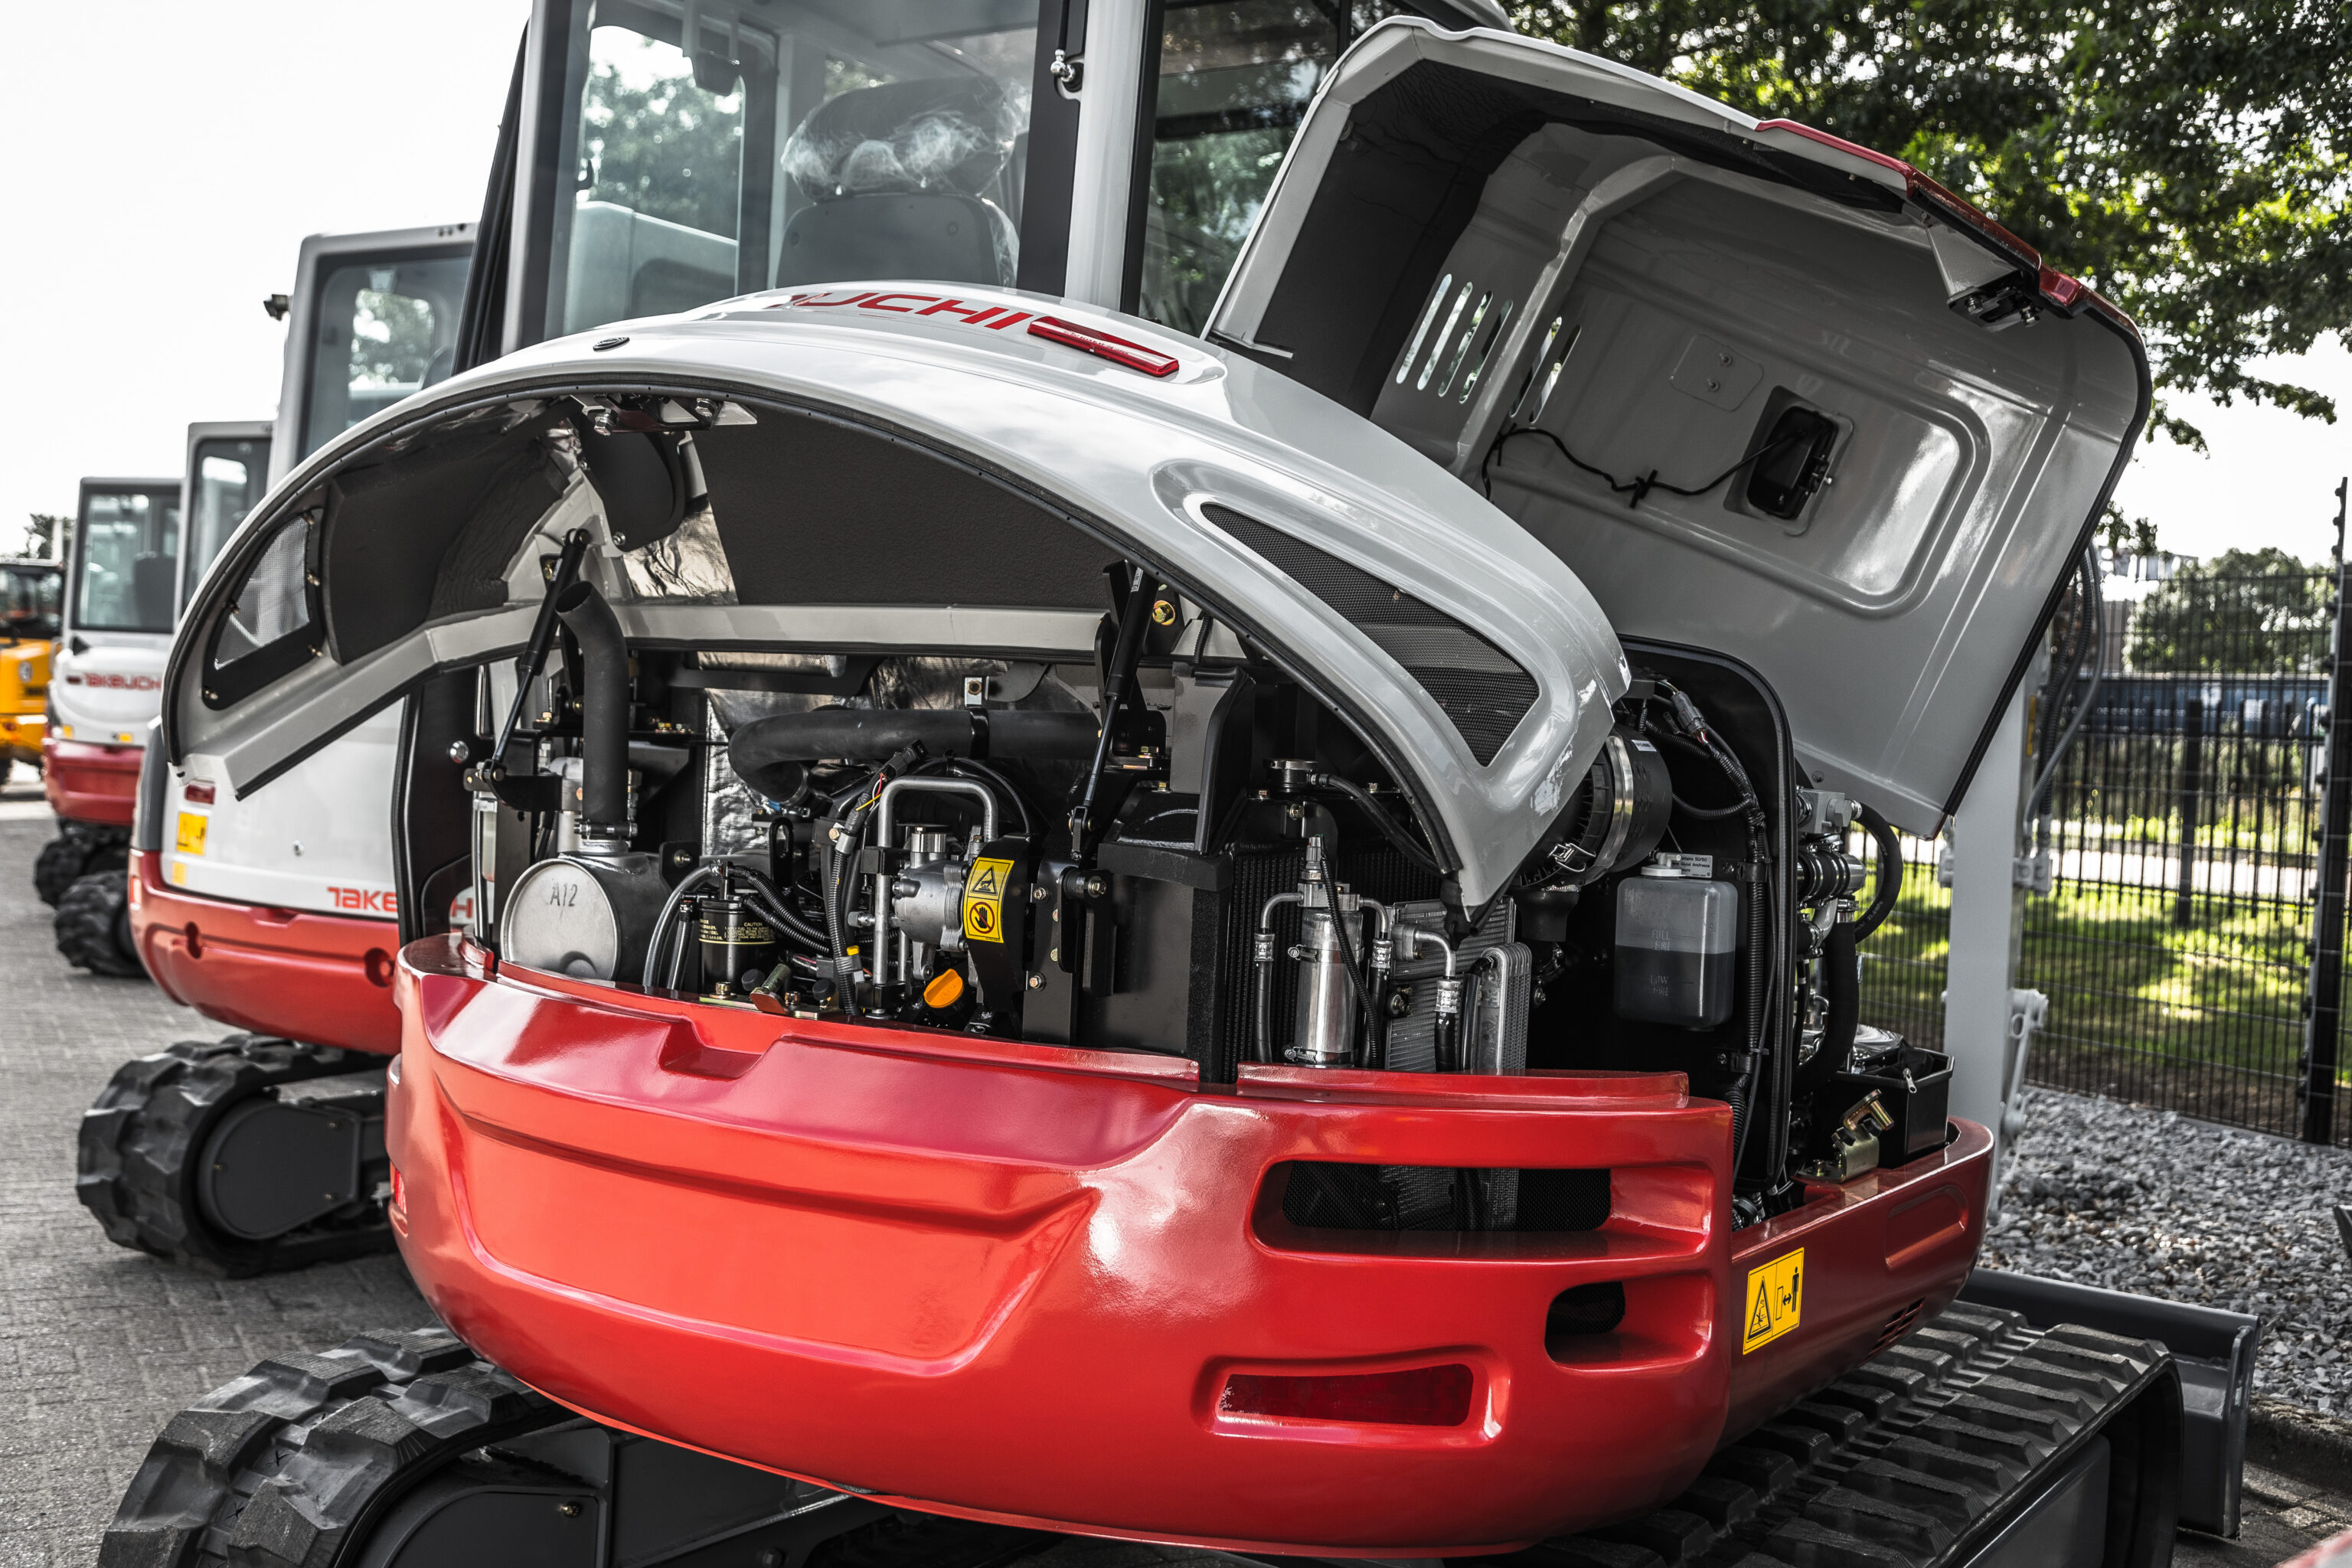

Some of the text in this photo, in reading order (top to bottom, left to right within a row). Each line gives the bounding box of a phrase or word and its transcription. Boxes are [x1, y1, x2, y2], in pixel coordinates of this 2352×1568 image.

[83, 672, 162, 691] TAKEUCH
[550, 882, 578, 906] A12
[1651, 929, 1670, 941] FULL
